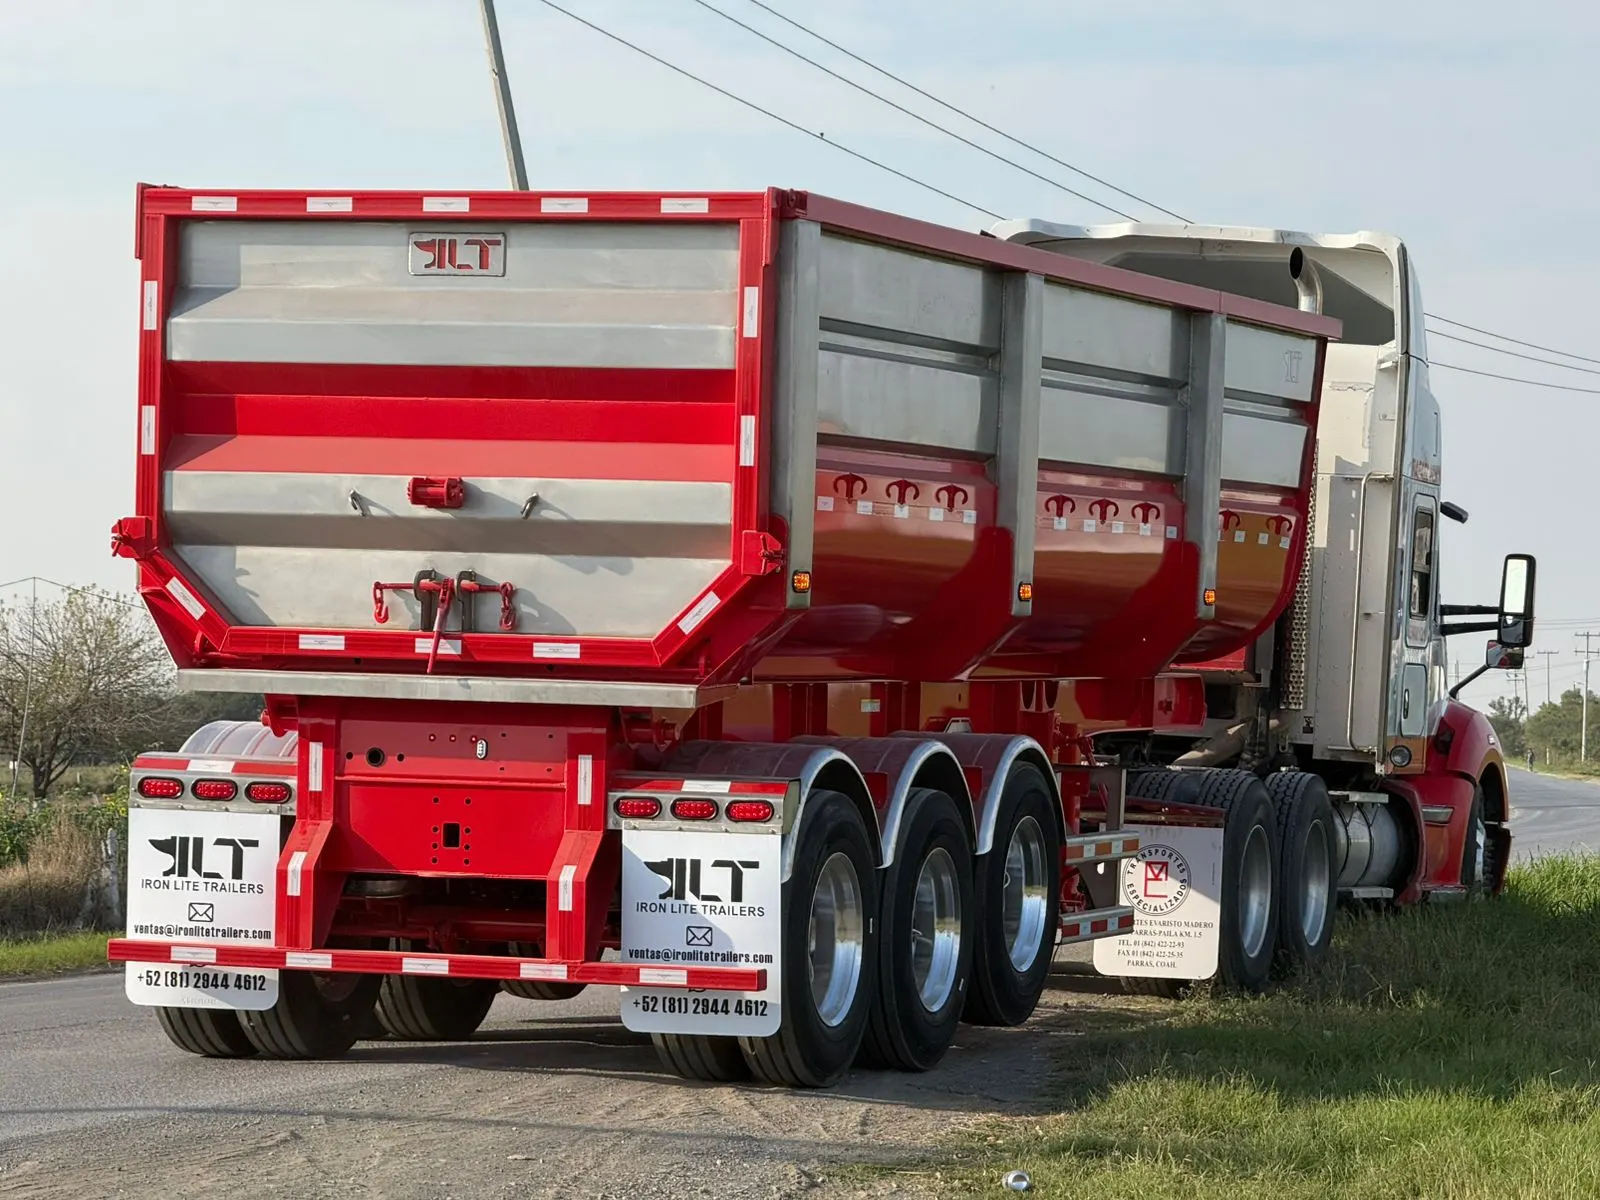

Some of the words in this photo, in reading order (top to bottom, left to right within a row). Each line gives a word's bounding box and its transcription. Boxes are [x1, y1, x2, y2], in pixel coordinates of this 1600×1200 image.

[1127, 848, 1186, 875] TRANSPORTES
[141, 879, 170, 890] IRON
[173, 880, 200, 891] LITE
[204, 881, 264, 894] TRAILERS
[1127, 878, 1188, 912] ESPECIALIZADOS
[636, 902, 667, 913] IRON
[671, 903, 697, 915] LITE
[701, 904, 765, 917] TRAILERS
[134, 923, 272, 940] ventas@ironlitetrailers.com
[1149, 920, 1183, 928] EVARISTO
[1184, 921, 1214, 929] MADERO
[628, 948, 773, 964] ventas@ironlitetrailers.com
[1117, 949, 1131, 957] FAX
[137, 970, 161, 987] +52
[164, 971, 190, 988] (81)
[193, 972, 230, 989] 2944
[234, 974, 267, 991] 4612
[633, 995, 658, 1013] +52
[662, 997, 688, 1015] (81)
[692, 997, 730, 1016] 2944
[734, 999, 768, 1017] 4612
